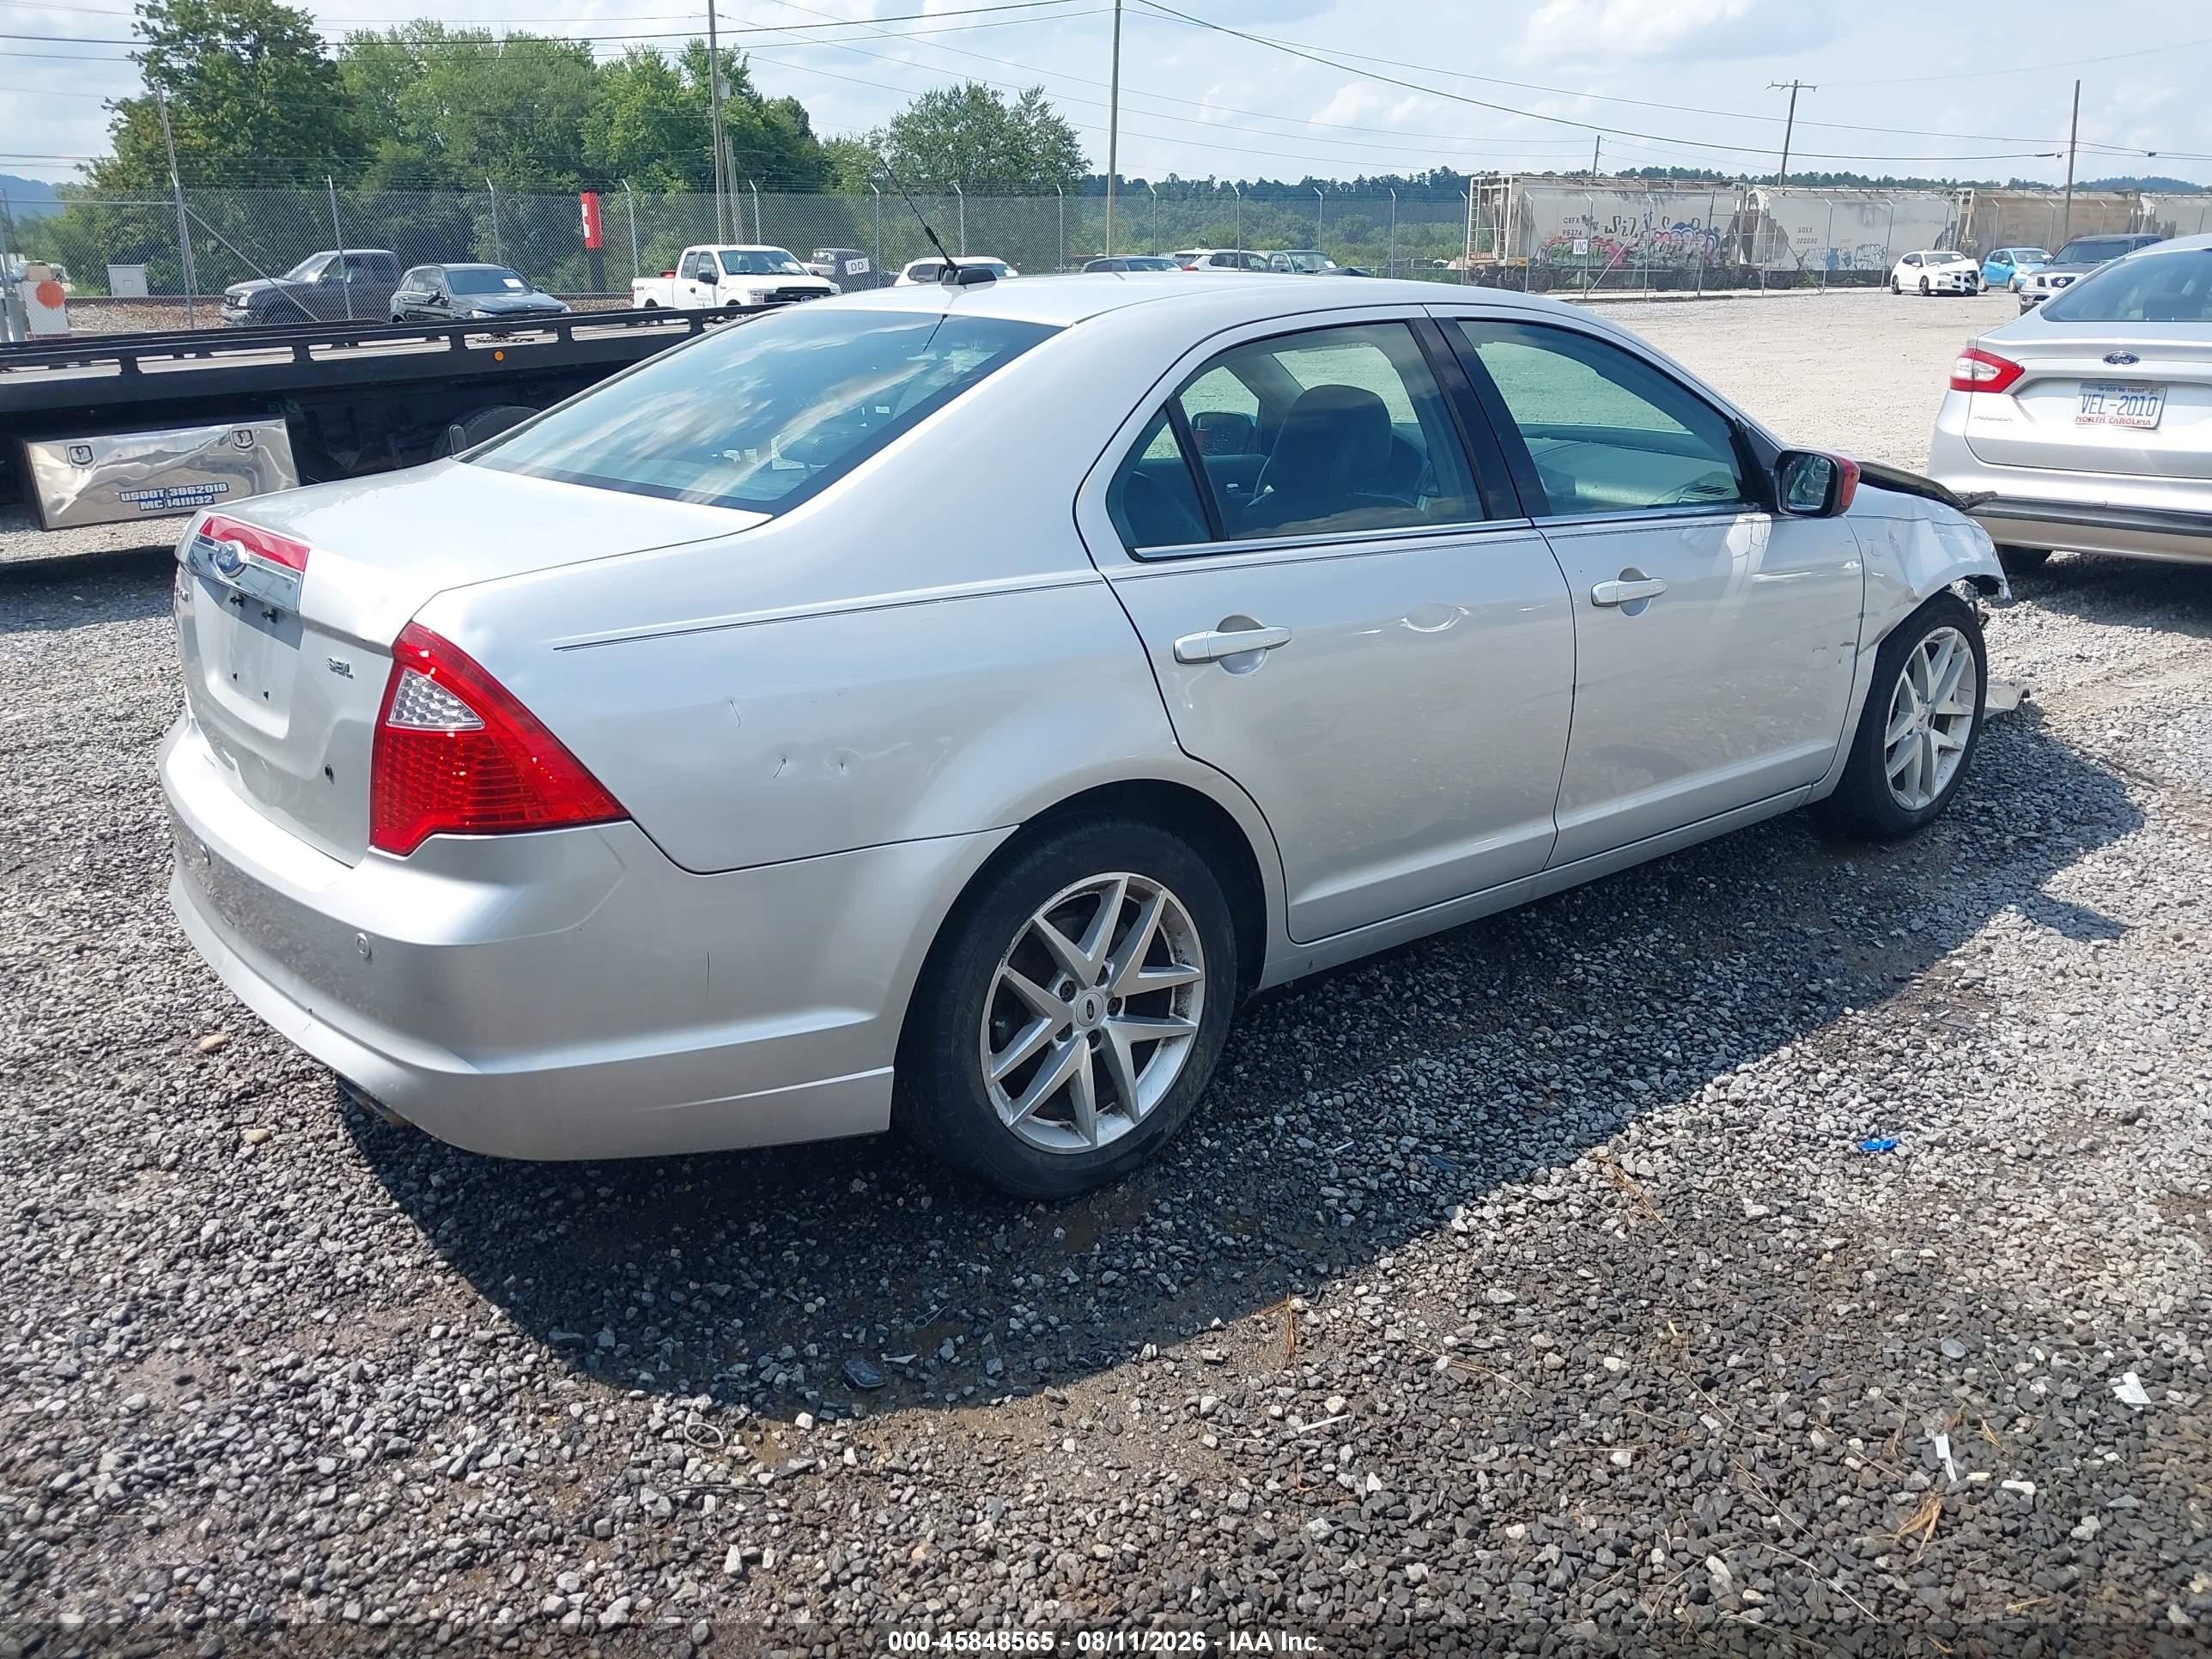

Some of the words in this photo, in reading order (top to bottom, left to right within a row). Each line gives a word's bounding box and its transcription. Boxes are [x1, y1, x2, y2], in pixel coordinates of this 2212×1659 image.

[1575, 241, 1587, 252] VIC
[850, 261, 864, 270] DD
[2081, 393, 2158, 417] VEL-2010
[2108, 417, 2151, 426] CAROLINA
[121, 489, 165, 501] USDOT
[139, 499, 164, 509] MC
[167, 495, 213, 507] 1411132
